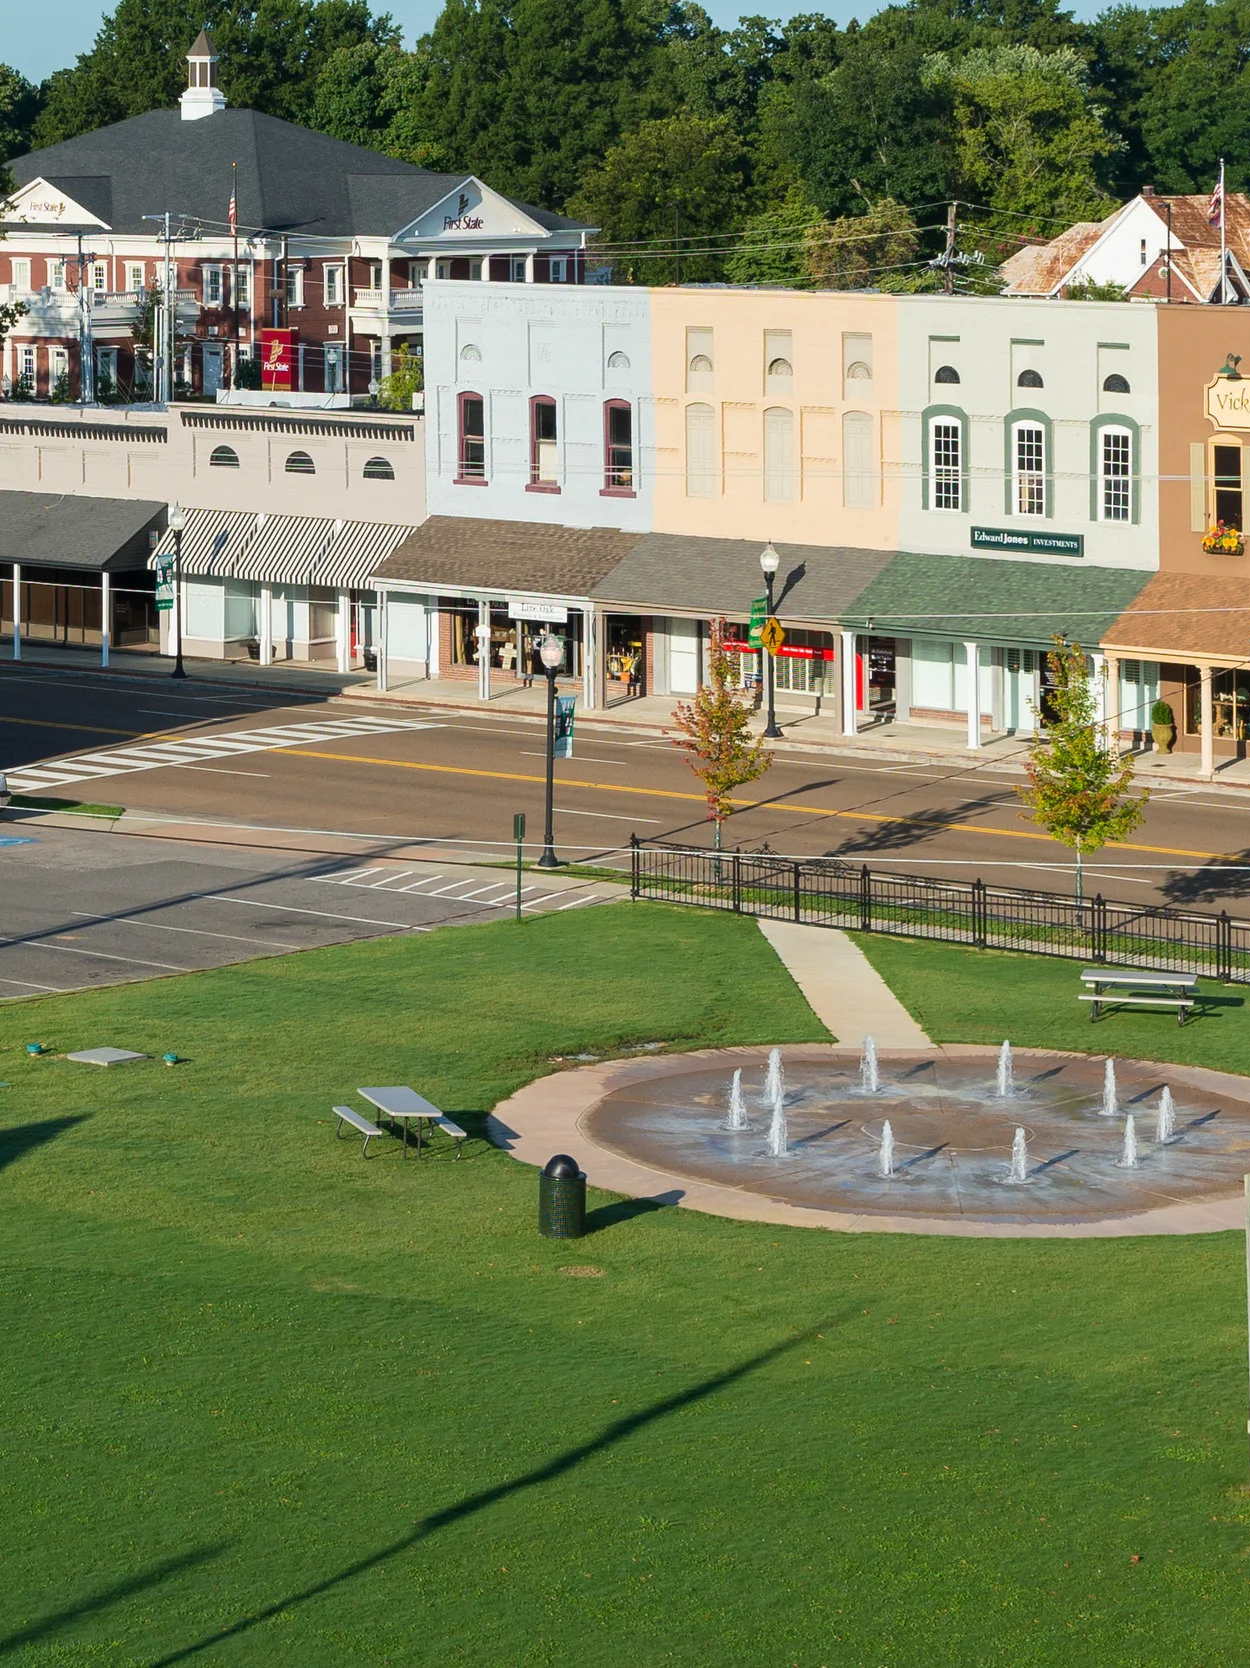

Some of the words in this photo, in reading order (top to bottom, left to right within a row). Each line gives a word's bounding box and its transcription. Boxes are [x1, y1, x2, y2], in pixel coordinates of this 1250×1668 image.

[443, 215, 461, 231] First
[462, 215, 484, 230] State
[263, 361, 275, 371] First
[275, 361, 289, 372] State
[1033, 538, 1078, 549] INVESTMENTS
[521, 603, 537, 612] Live
[539, 604, 555, 614] Oak
